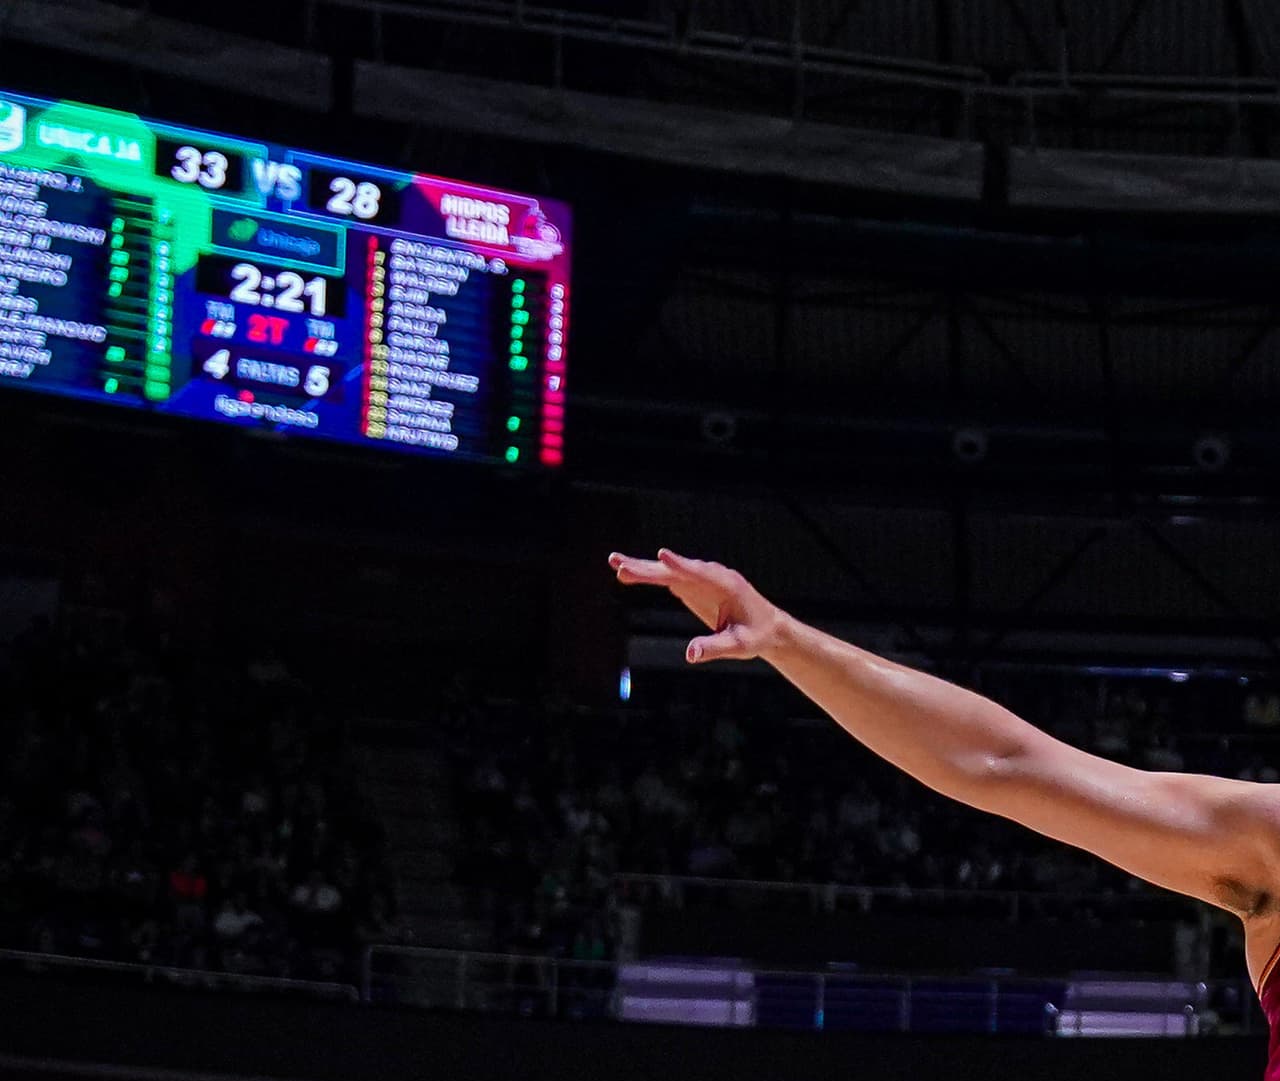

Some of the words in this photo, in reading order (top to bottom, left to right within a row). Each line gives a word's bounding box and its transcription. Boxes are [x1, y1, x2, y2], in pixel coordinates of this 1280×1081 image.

[171, 146, 229, 189] 33
[252, 157, 302, 201] VS
[326, 177, 381, 219] 28
[229, 263, 327, 317] 2:21
[247, 314, 290, 345] 2T
[203, 349, 231, 380] 4
[304, 365, 331, 397] 5
